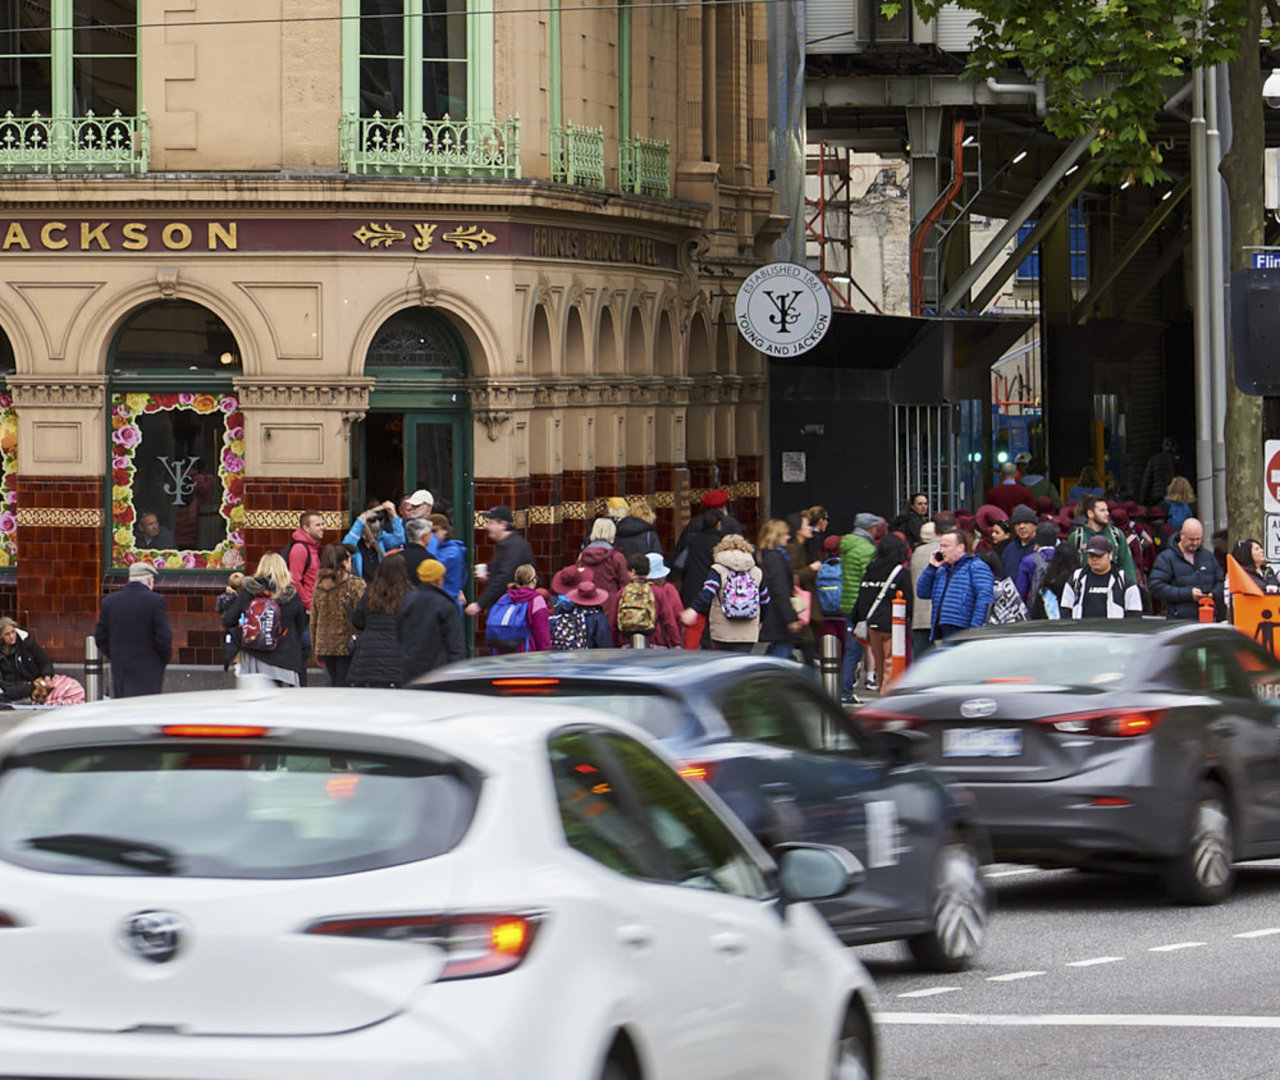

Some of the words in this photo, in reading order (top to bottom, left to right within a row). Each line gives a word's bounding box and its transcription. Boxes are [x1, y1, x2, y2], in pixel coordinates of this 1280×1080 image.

[742, 265, 801, 295] ESTABLISHED
[803, 272, 823, 293] 1861
[738, 312, 765, 348] YOUNG
[765, 344, 790, 356] AND
[793, 314, 829, 354] JACKSON
